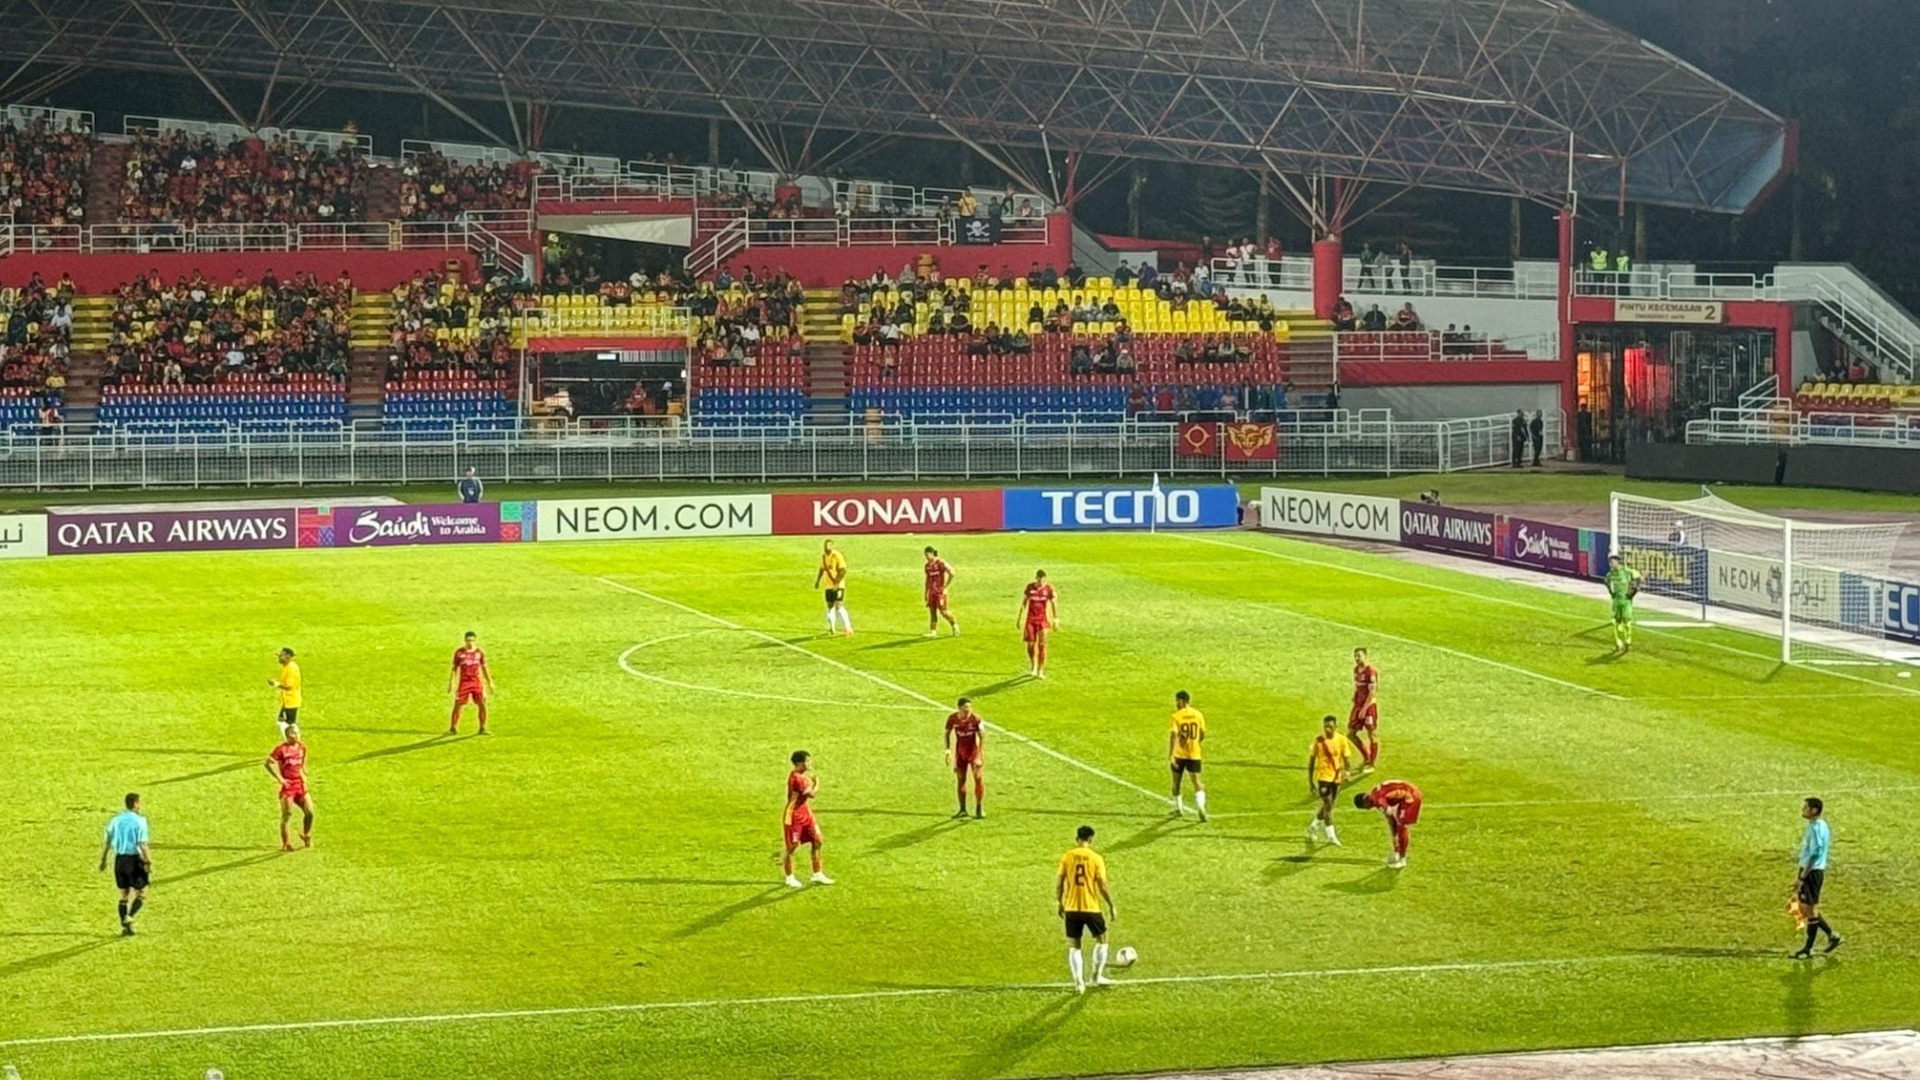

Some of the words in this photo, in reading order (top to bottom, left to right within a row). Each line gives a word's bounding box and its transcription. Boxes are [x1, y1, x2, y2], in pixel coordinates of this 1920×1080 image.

[1620, 303, 1646, 312] PINTU
[1704, 305, 1716, 320] 2
[431, 515, 478, 525] Welcome
[556, 502, 754, 534] NEOM.COM
[812, 497, 962, 527] KONAMI
[1271, 495, 1389, 533] NEOM.COM
[57, 520, 155, 547] QATAR
[167, 517, 288, 542] AIRWAYS
[440, 526, 451, 535] to
[1402, 510, 1439, 538] QATAR
[1443, 514, 1492, 546] AIRWAYS
[1719, 565, 1761, 593] NEOM
[1180, 722, 1198, 740] 90
[1075, 863, 1086, 887] 2
